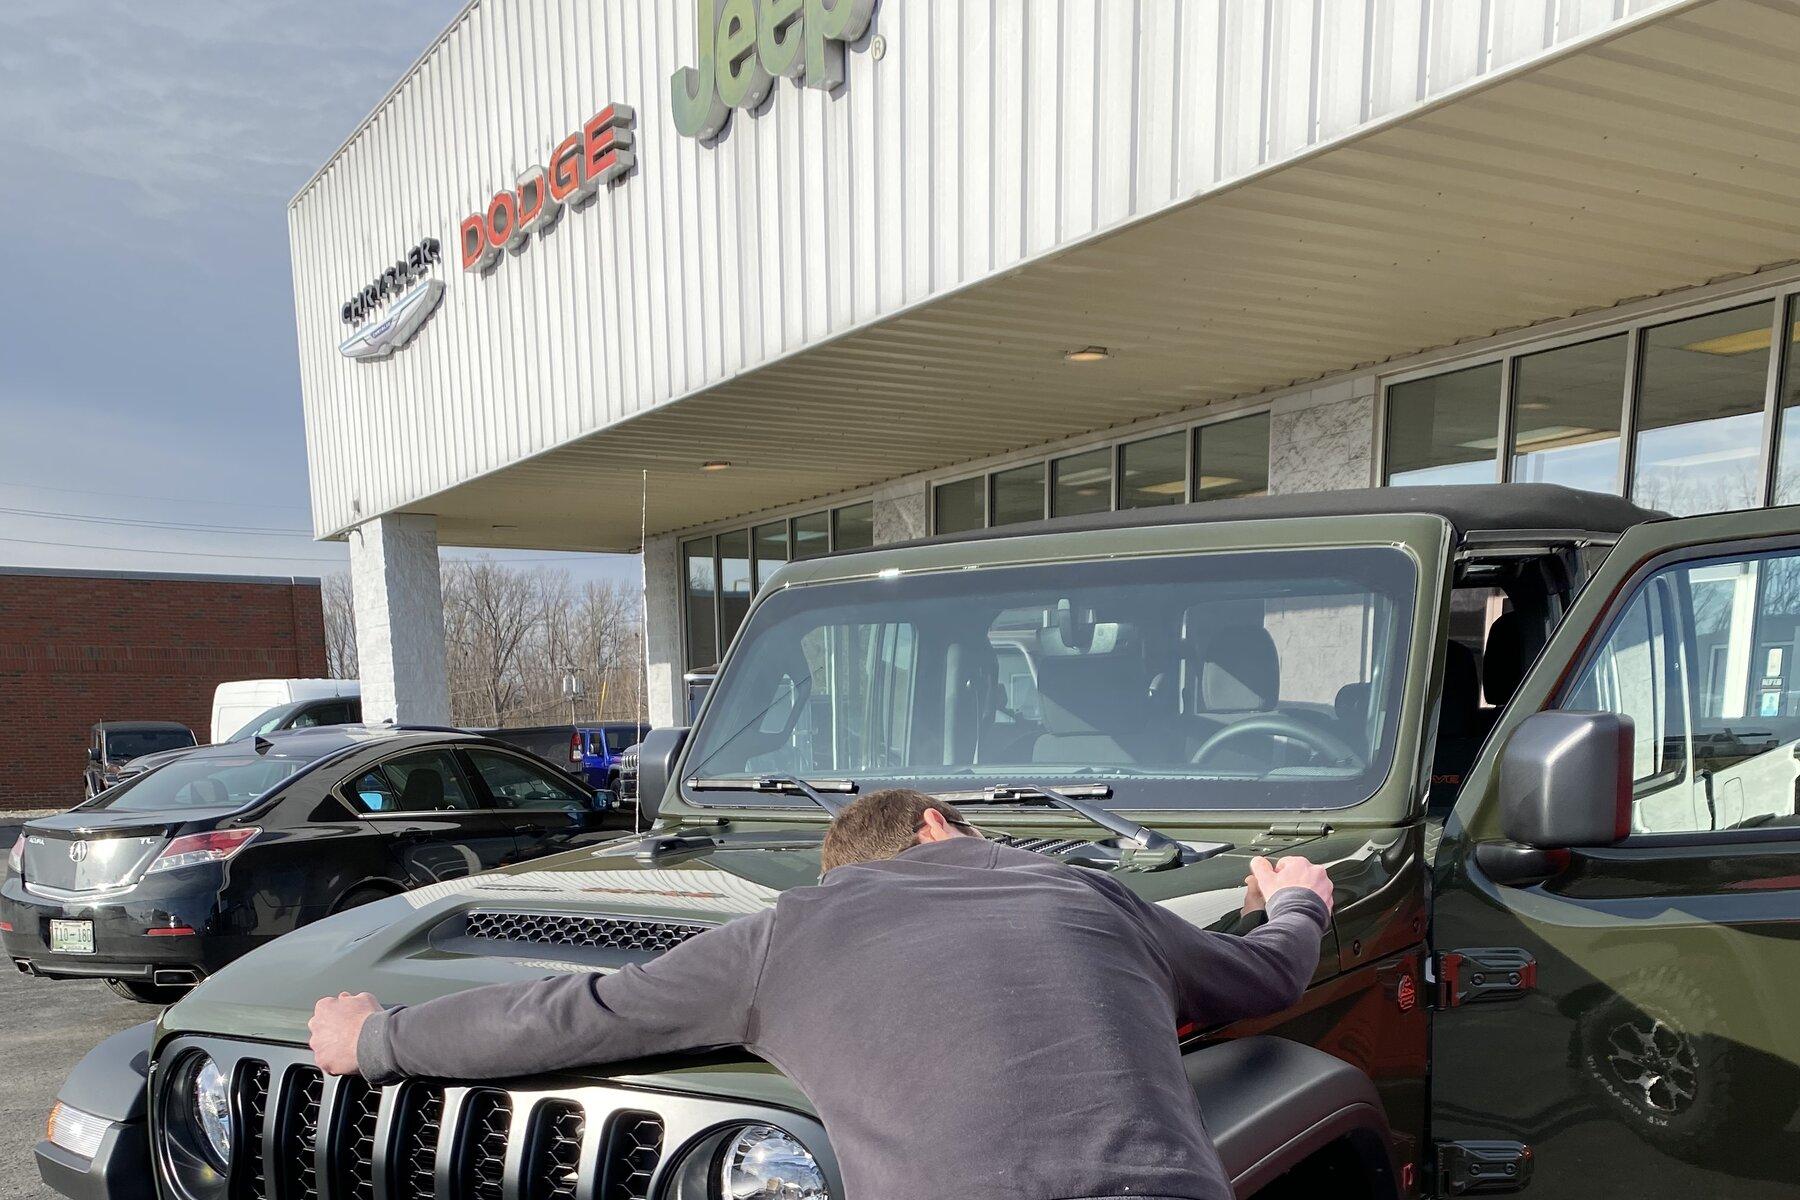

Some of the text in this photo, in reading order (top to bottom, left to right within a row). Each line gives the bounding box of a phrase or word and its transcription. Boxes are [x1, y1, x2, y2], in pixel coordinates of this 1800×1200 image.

[670, 0, 878, 138] Jeep
[461, 102, 632, 272] DODGE
[341, 237, 440, 325] CHRYSLER
